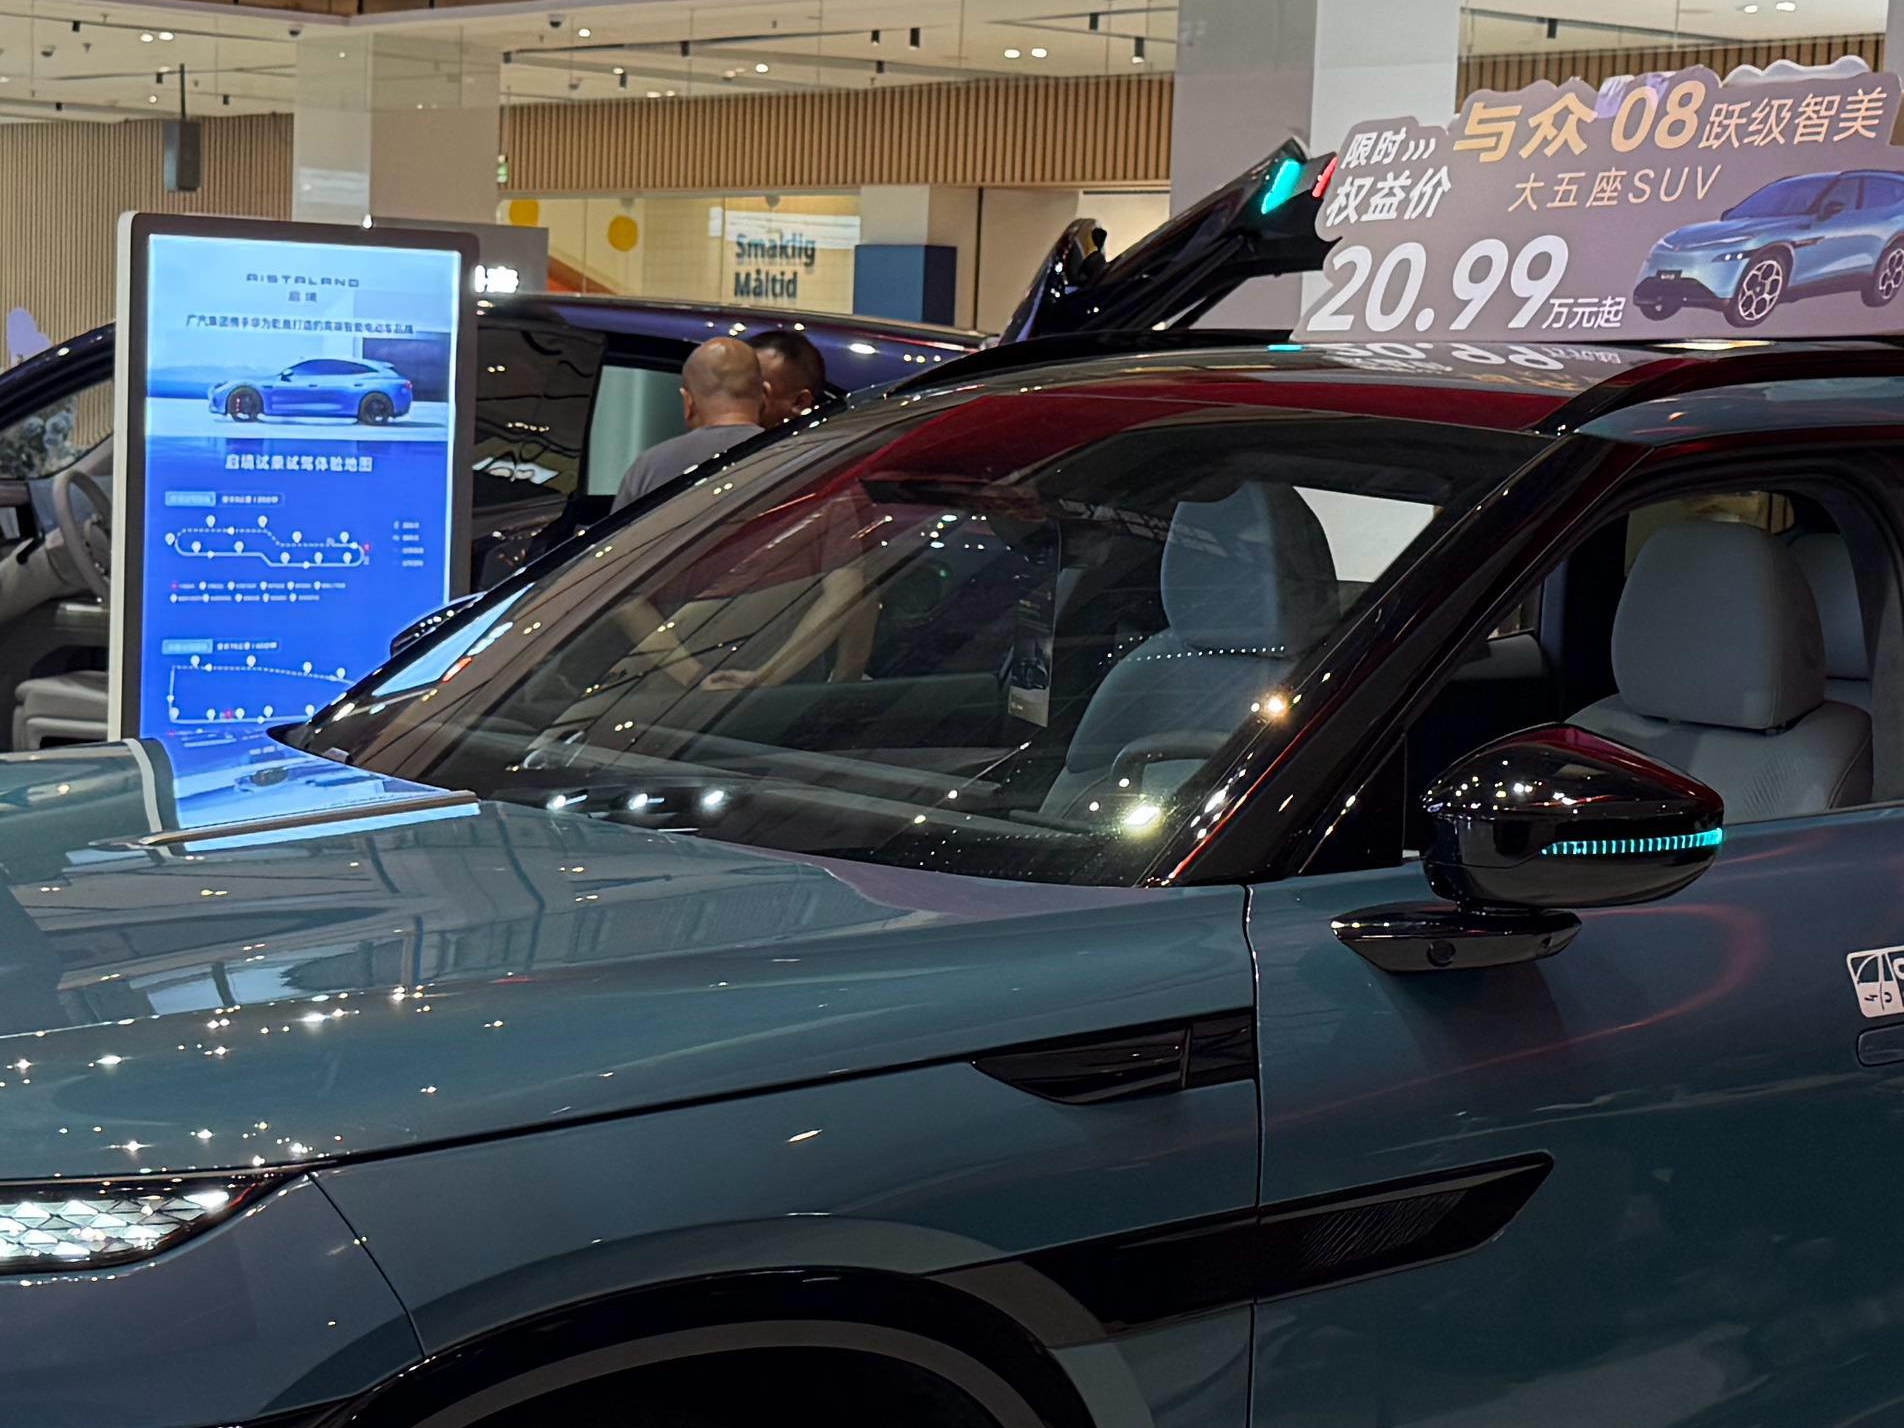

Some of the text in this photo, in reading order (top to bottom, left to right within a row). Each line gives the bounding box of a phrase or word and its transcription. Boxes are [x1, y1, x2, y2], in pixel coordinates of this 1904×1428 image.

[1453, 82, 1888, 163] 与众 08 跃级智美
[1340, 128, 1408, 170] 限时
[1325, 165, 1451, 228] 权益价
[1507, 164, 1722, 214] 大五座SUV
[734, 231, 817, 266] Smaklig
[733, 269, 799, 299] Måltid
[1306, 234, 1627, 333] 20.99 万元起
